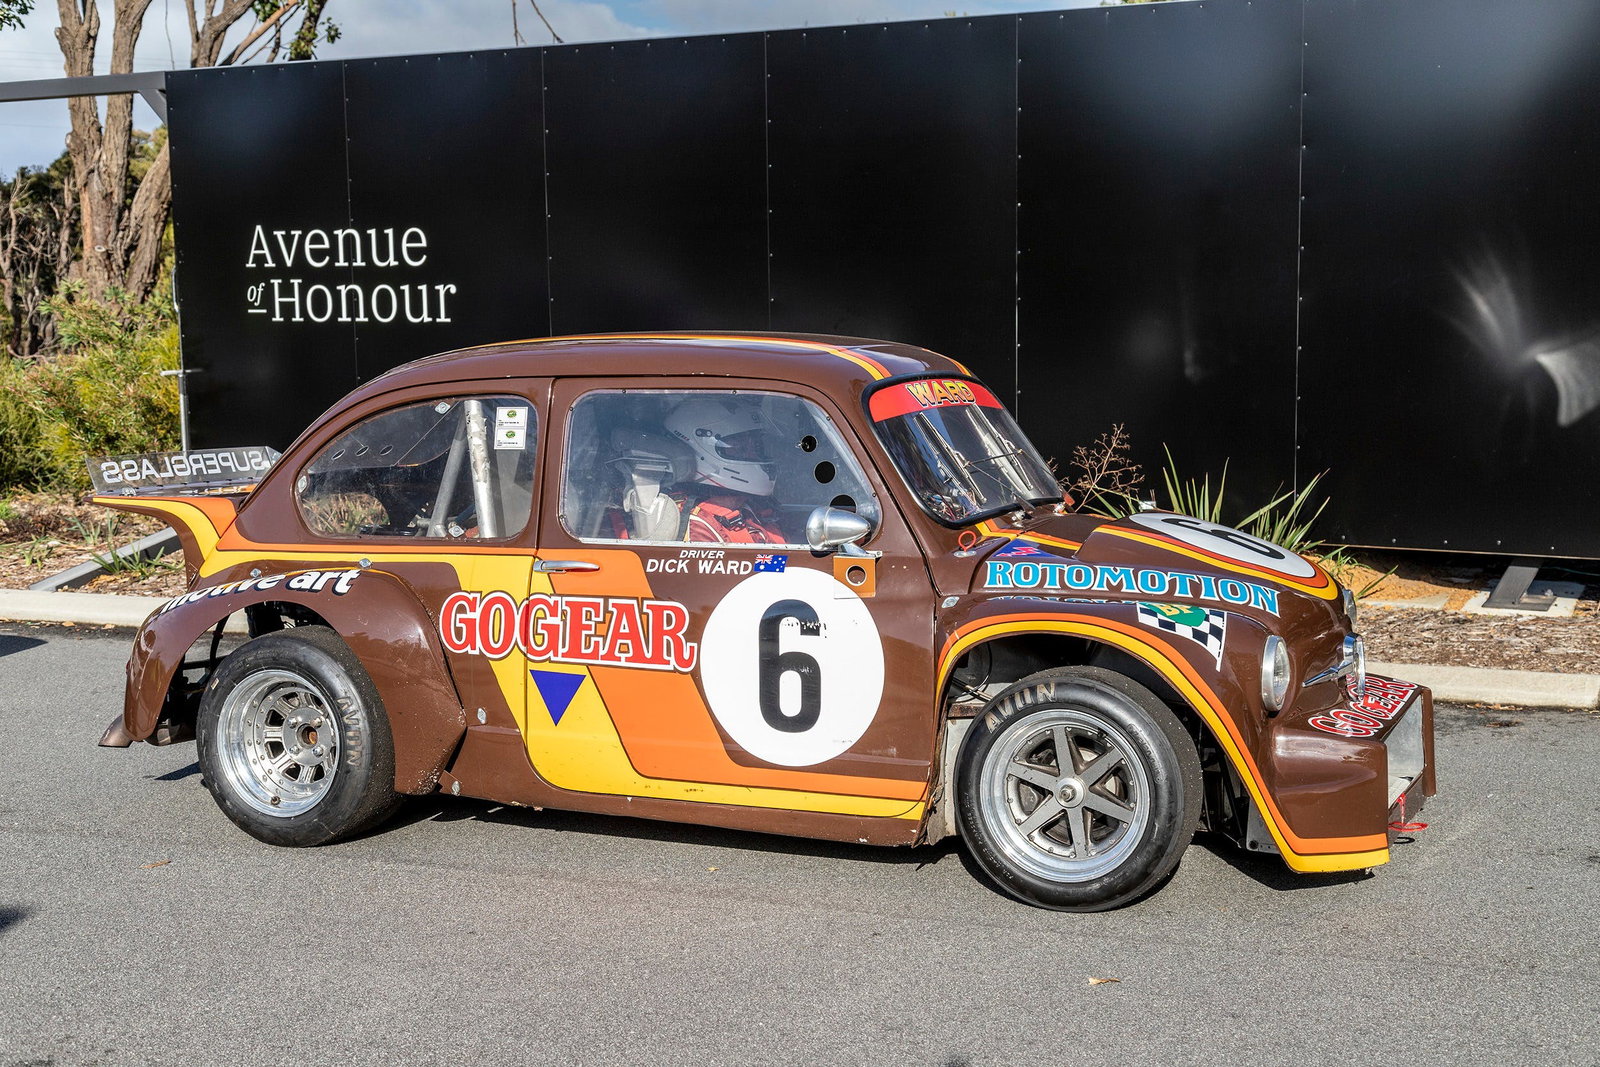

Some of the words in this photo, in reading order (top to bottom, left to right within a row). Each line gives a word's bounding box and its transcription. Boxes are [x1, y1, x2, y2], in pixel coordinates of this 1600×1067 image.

[246, 224, 427, 267] Avenue
[247, 282, 266, 312] of
[270, 278, 457, 323] Honour
[907, 380, 976, 407] WARD
[679, 550, 725, 559] DRIVER
[1161, 518, 1286, 560] 6
[285, 569, 362, 597] art
[645, 558, 689, 574] DICK
[698, 559, 752, 575] WARD
[983, 560, 1281, 618] ROTOMOTION
[438, 590, 698, 674] GOGEAR
[758, 598, 822, 734] 6
